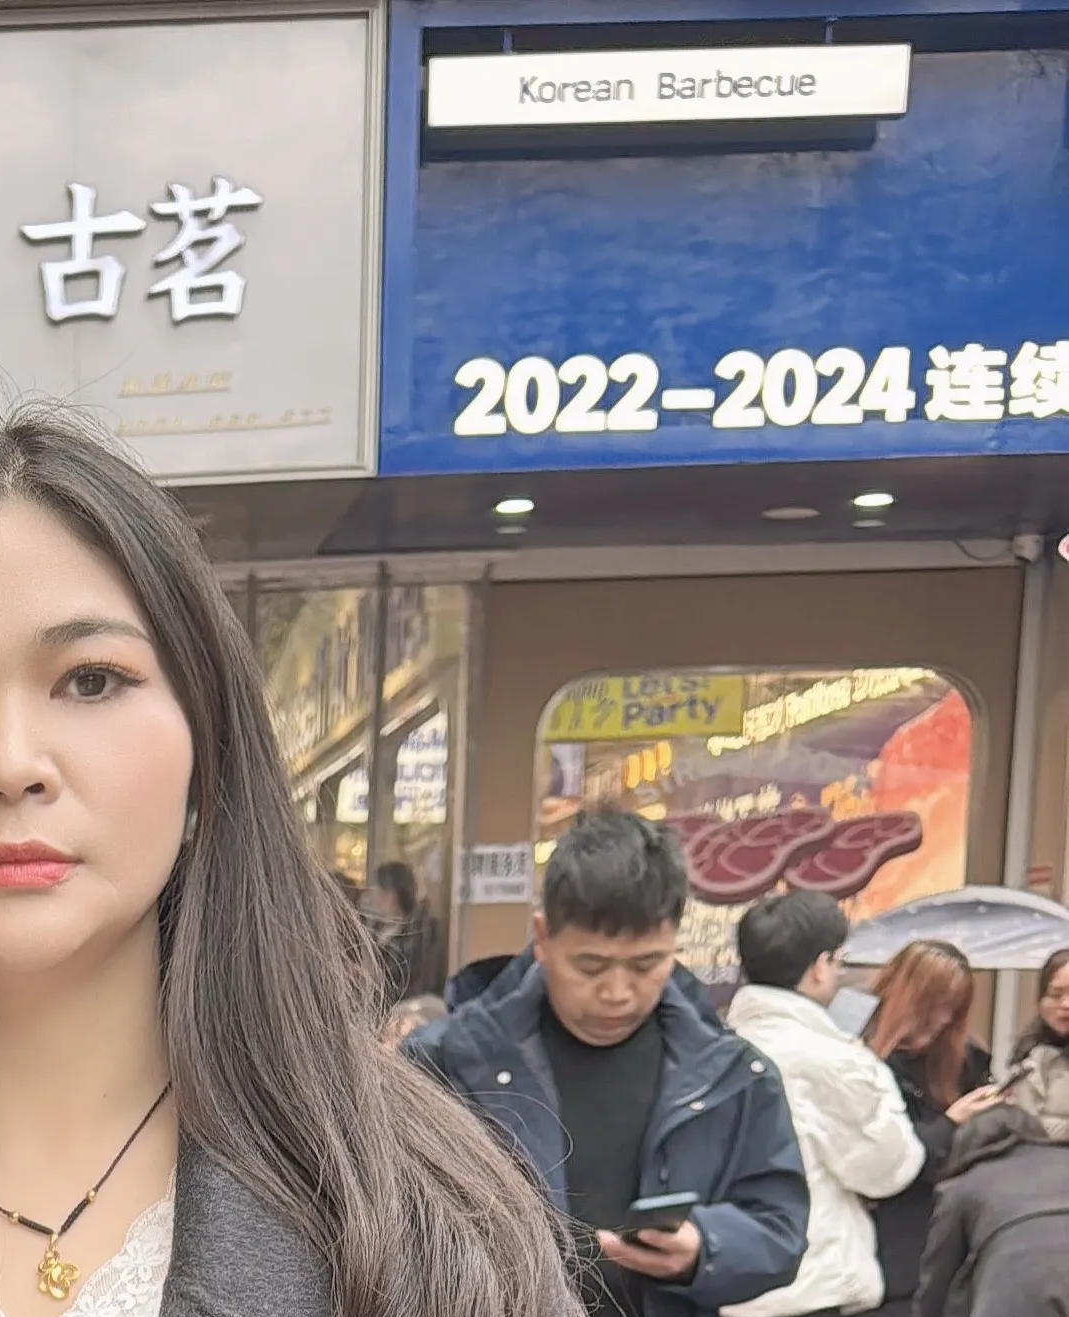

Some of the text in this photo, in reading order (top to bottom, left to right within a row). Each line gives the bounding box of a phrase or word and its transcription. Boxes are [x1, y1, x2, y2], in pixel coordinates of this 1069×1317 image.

[518, 69, 817, 104] Korean Barbecue
[20, 177, 263, 325] 古茗
[622, 693, 724, 729] Party
